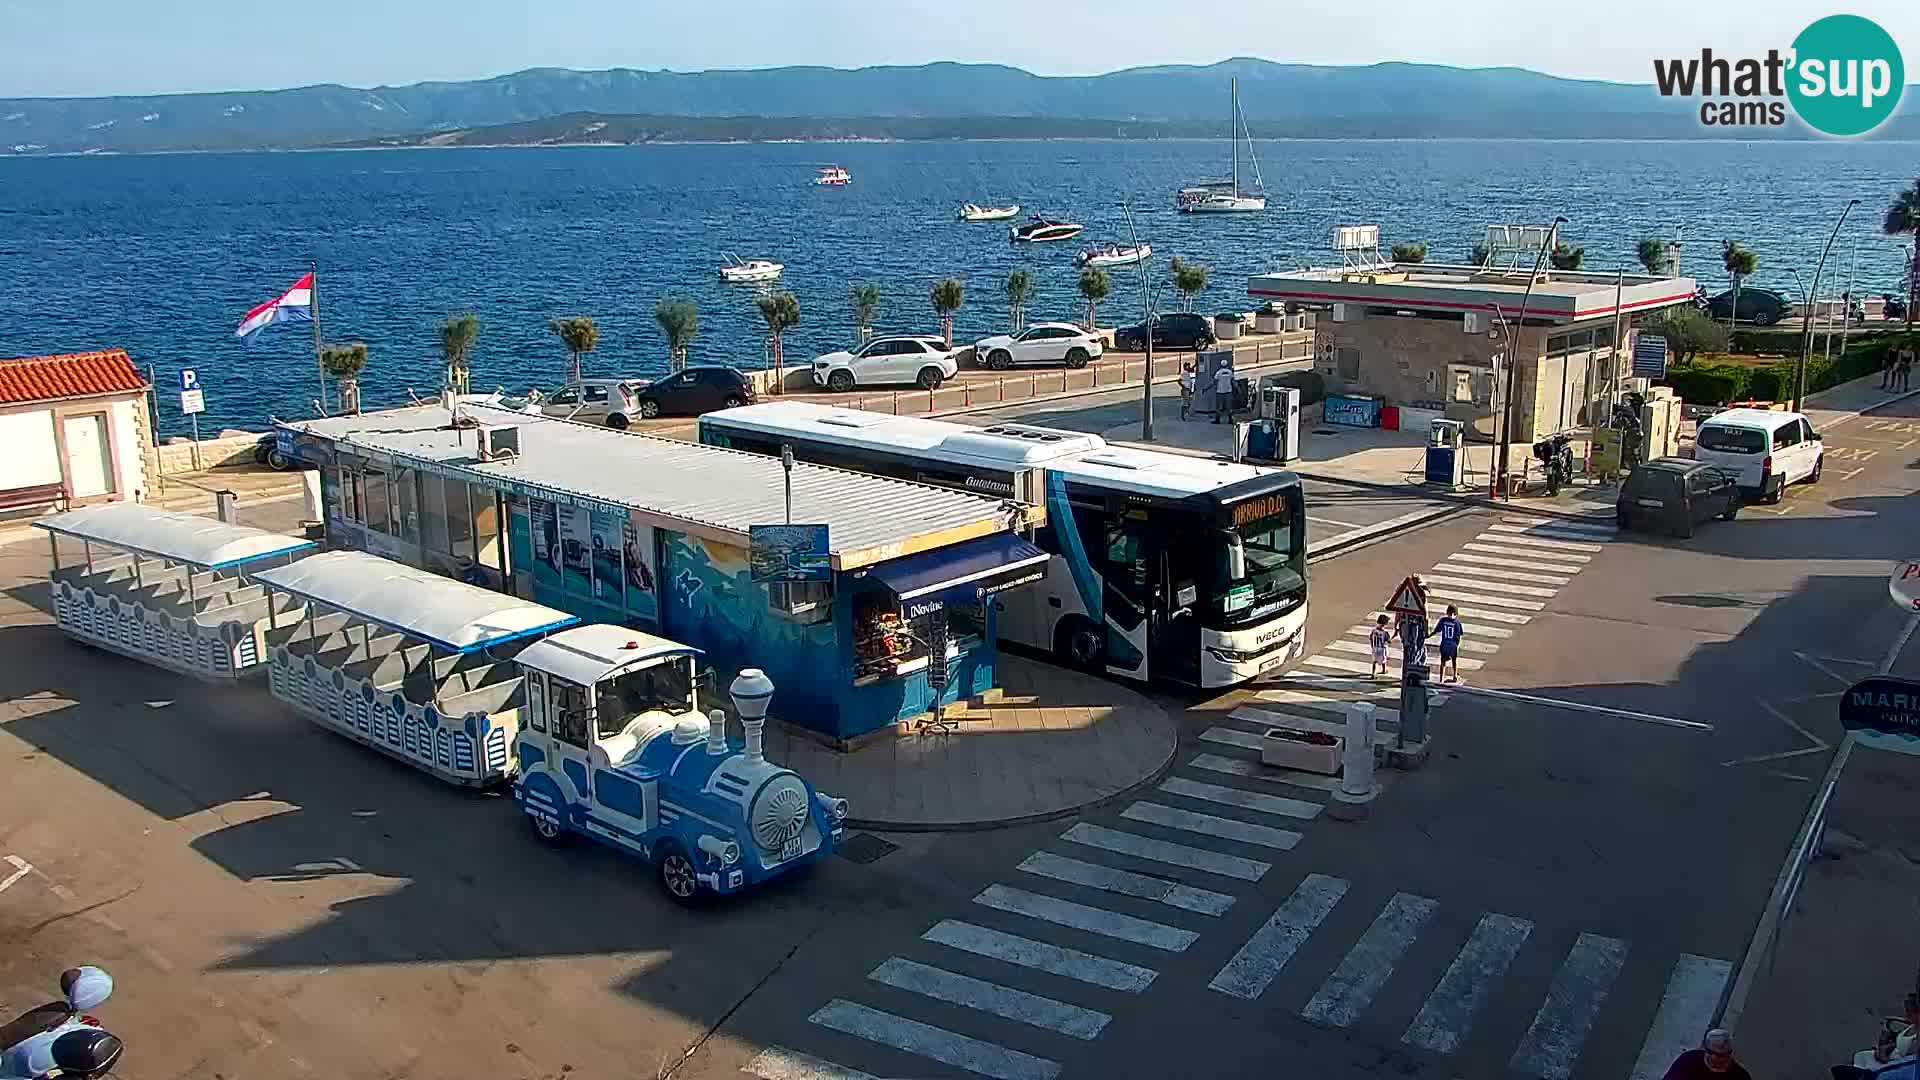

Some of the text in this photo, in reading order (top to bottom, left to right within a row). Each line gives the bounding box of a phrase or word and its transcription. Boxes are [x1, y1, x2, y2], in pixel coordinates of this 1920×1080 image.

[183, 369, 197, 389] P
[539, 487, 571, 505] STATION
[572, 495, 600, 511] TICKET
[600, 501, 628, 518] OFFICE
[1256, 626, 1285, 645] IVECO
[1444, 624, 1454, 639] 10
[1852, 691, 1920, 710] MARI
